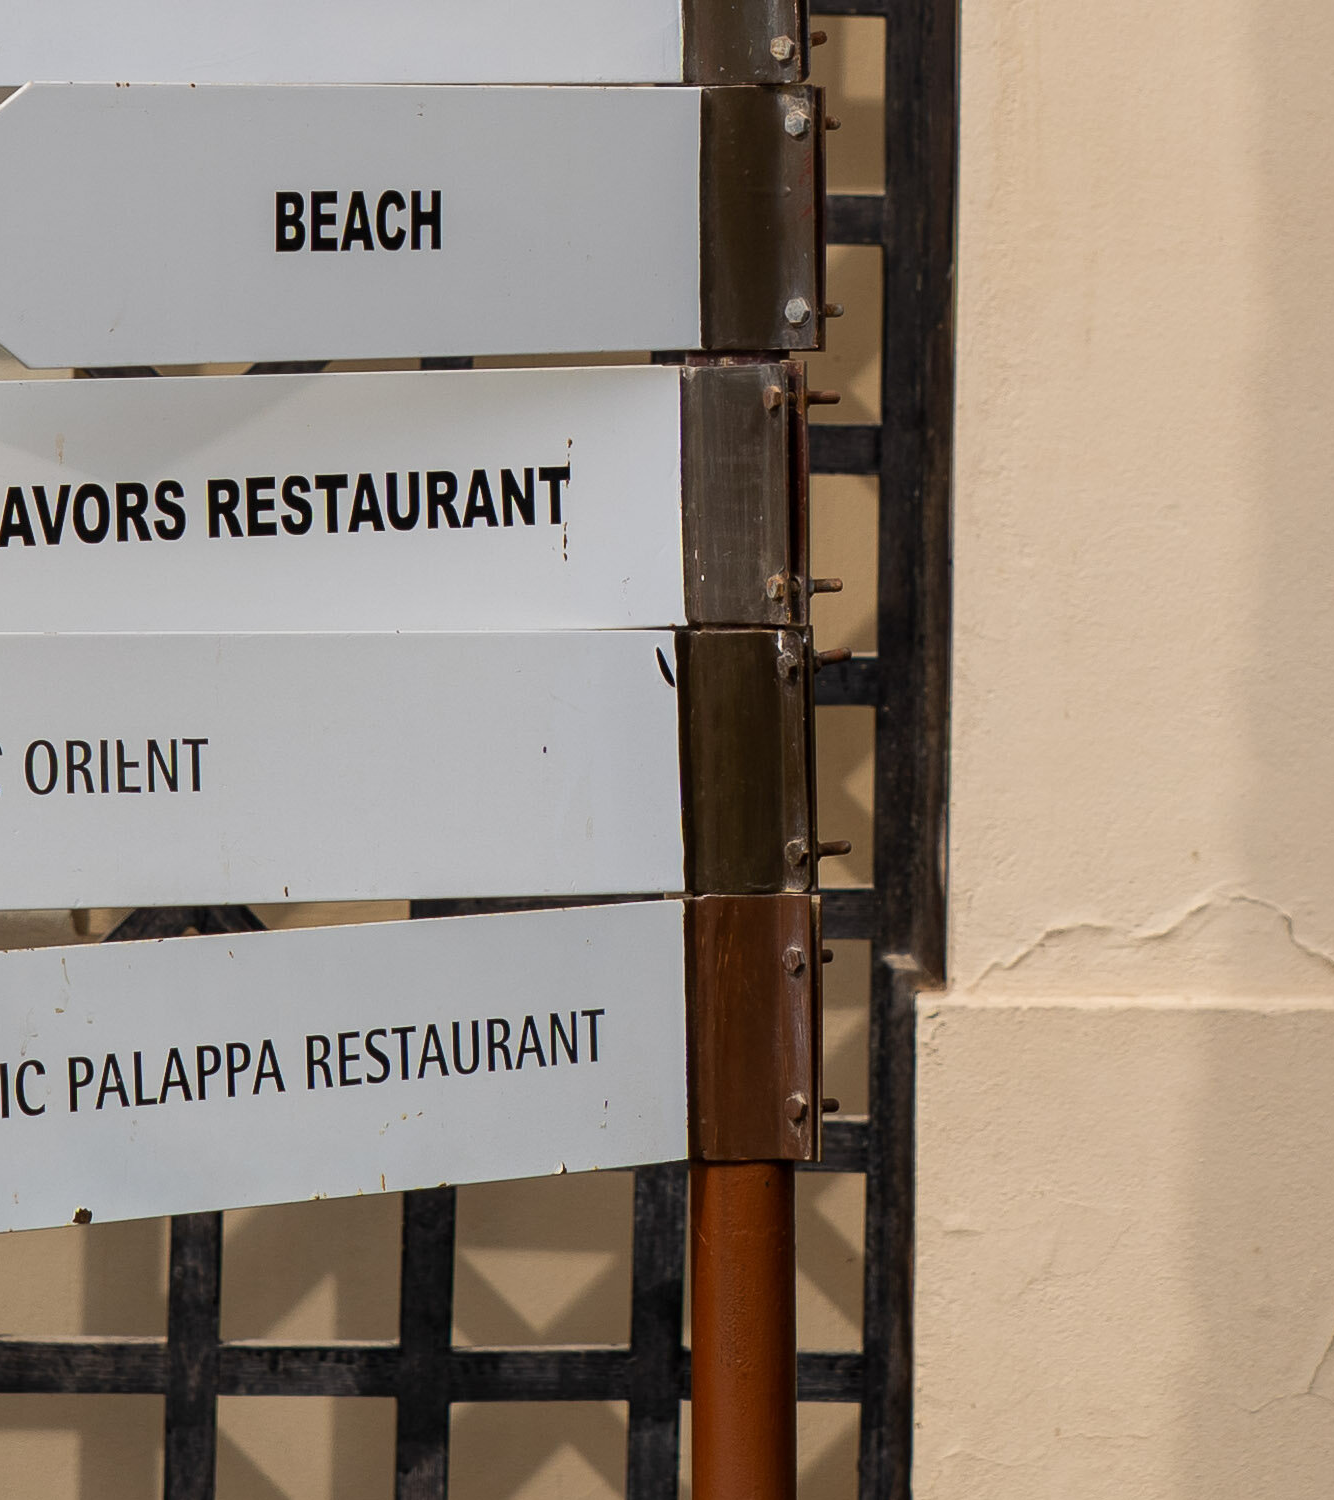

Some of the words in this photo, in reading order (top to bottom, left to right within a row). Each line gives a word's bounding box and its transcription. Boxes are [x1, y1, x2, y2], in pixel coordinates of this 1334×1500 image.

[275, 189, 442, 253] BEACH
[207, 465, 571, 539] RESTAURANT
[24, 738, 209, 796] ORIENT
[68, 1038, 286, 1113] PALAPPA
[305, 1008, 605, 1090] RESTAURANT
